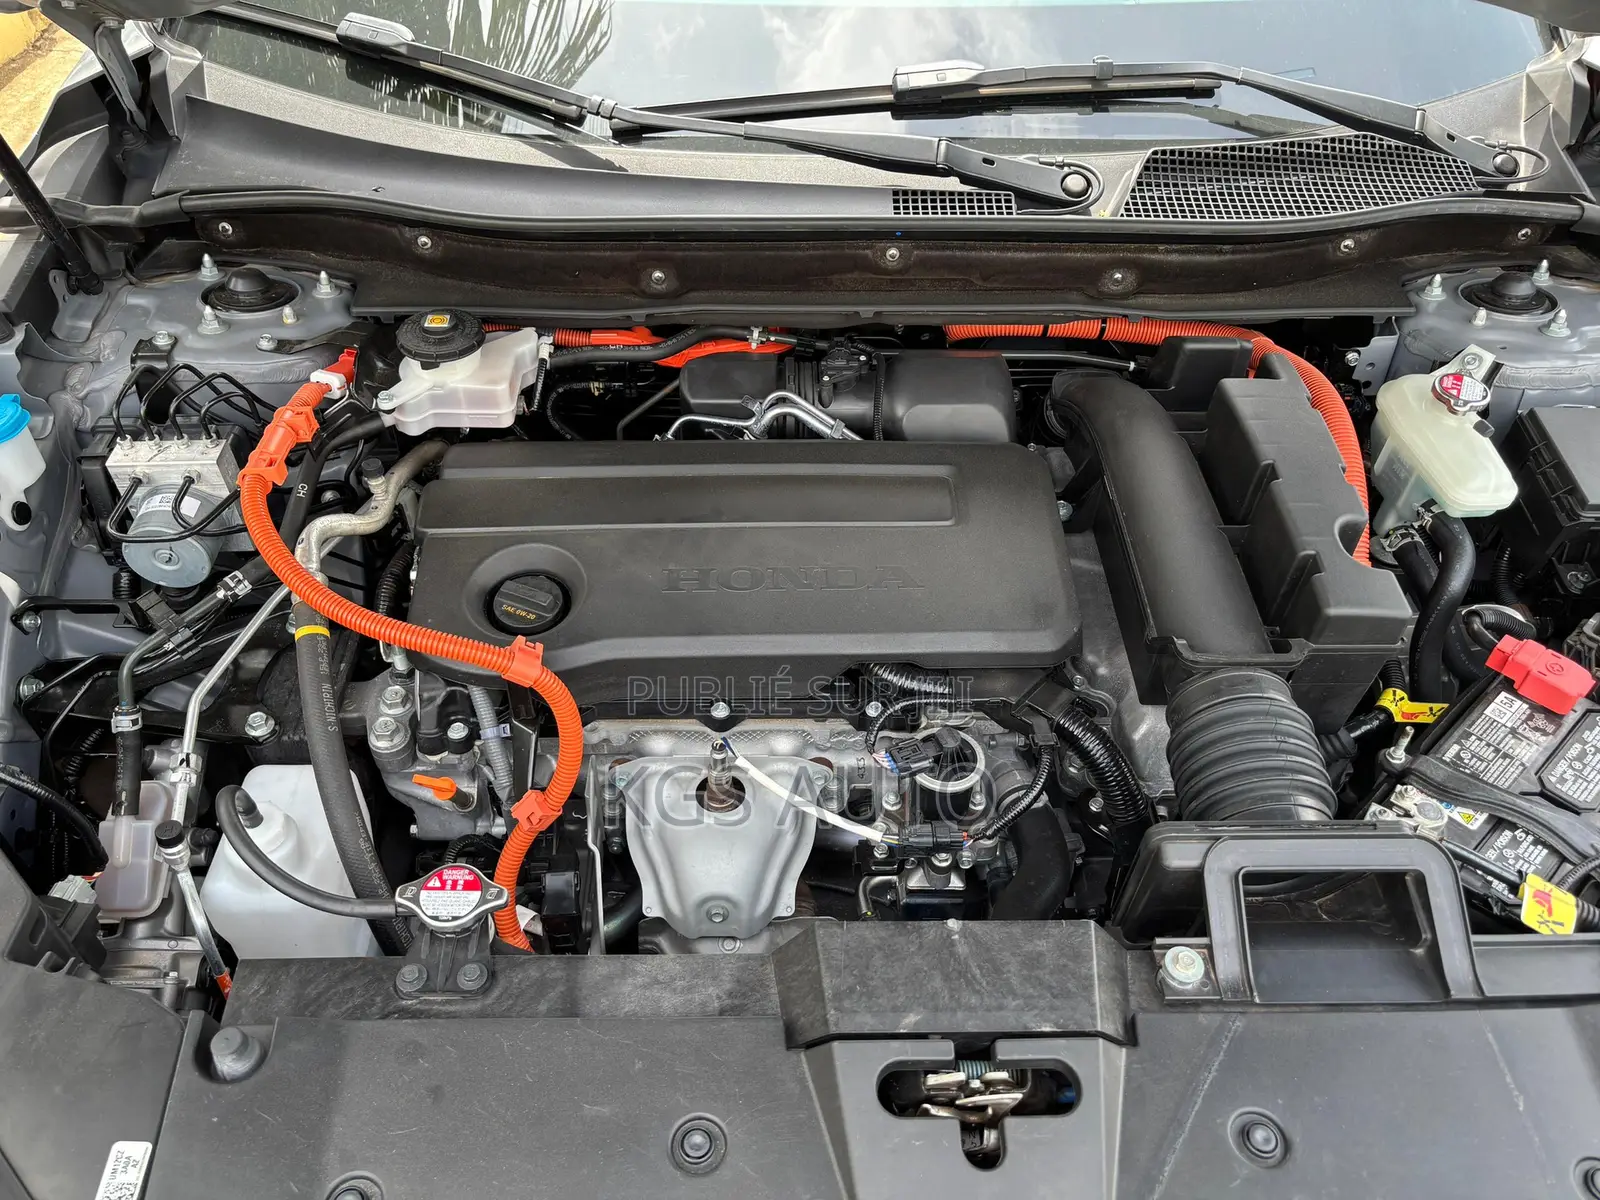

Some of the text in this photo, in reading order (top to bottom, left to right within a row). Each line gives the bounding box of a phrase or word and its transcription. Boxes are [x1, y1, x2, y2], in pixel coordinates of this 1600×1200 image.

[661, 565, 925, 593] HONDA
[501, 604, 536, 620] SAE 0W-20
